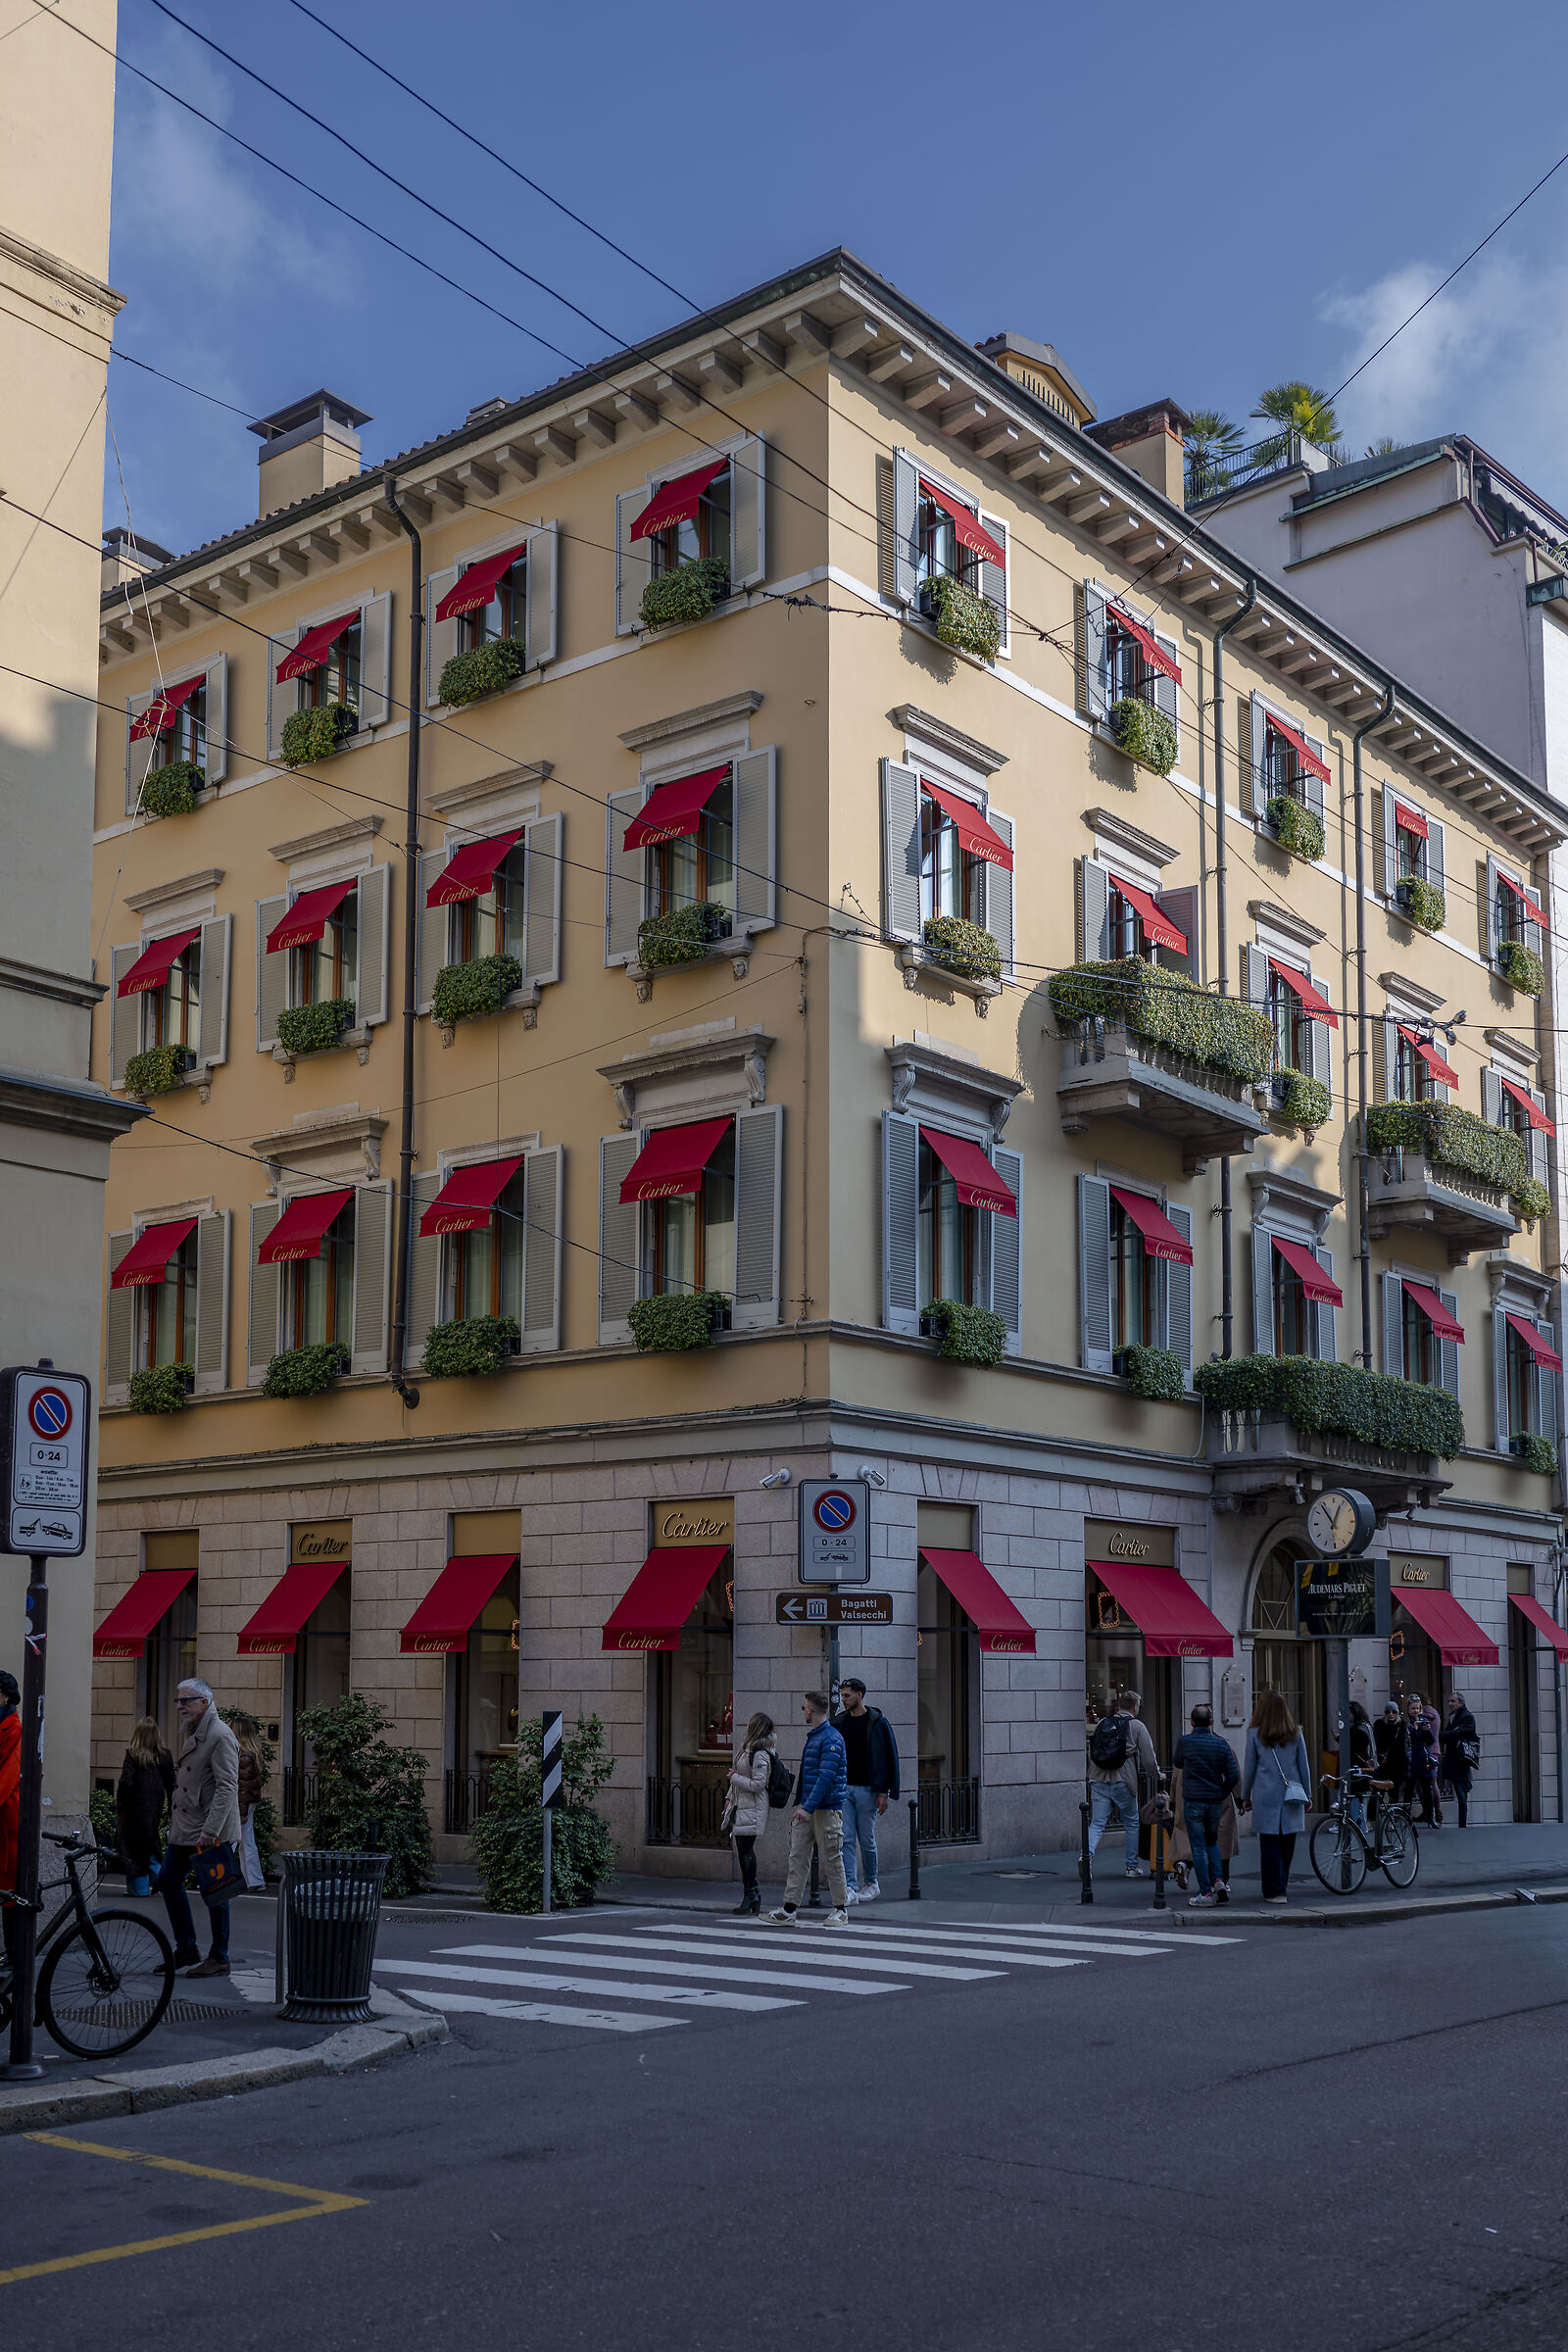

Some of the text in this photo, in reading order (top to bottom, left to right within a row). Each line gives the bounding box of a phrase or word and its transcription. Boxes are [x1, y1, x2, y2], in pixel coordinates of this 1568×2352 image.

[642, 513, 687, 536] Cartier
[963, 532, 997, 561] Cartier
[446, 597, 485, 617] Cartier
[1303, 757, 1325, 779] Cartier
[1401, 813, 1422, 834] Cartier
[969, 837, 1003, 863] Cartier
[439, 887, 478, 904] Cartier
[278, 932, 313, 949] Cartier
[1152, 927, 1180, 950] Cartier
[127, 977, 158, 994] Cartier
[1434, 1068, 1452, 1086] Cartier
[637, 1181, 684, 1200] Cartier
[970, 1189, 1004, 1211] Cartier
[435, 1216, 475, 1234] Cartier
[271, 1246, 308, 1261] Cartier
[1155, 1242, 1182, 1261] Cartier
[122, 1272, 154, 1287] Cartier
[1311, 1286, 1334, 1303] Cartier
[662, 1512, 729, 1539] Cartier
[297, 1533, 349, 1555] Cartier
[1109, 1532, 1151, 1556] Cartier
[1402, 1562, 1431, 1582] Cartier
[841, 1598, 877, 1610] Bagatti
[841, 1610, 887, 1619] Valsecchi
[100, 1642, 132, 1655] Cartier
[249, 1637, 285, 1652] Cartier
[414, 1632, 454, 1651] Cartier
[618, 1631, 664, 1648] Cartier
[991, 1634, 1024, 1651] Cartier
[1177, 1639, 1204, 1655] Cartier
